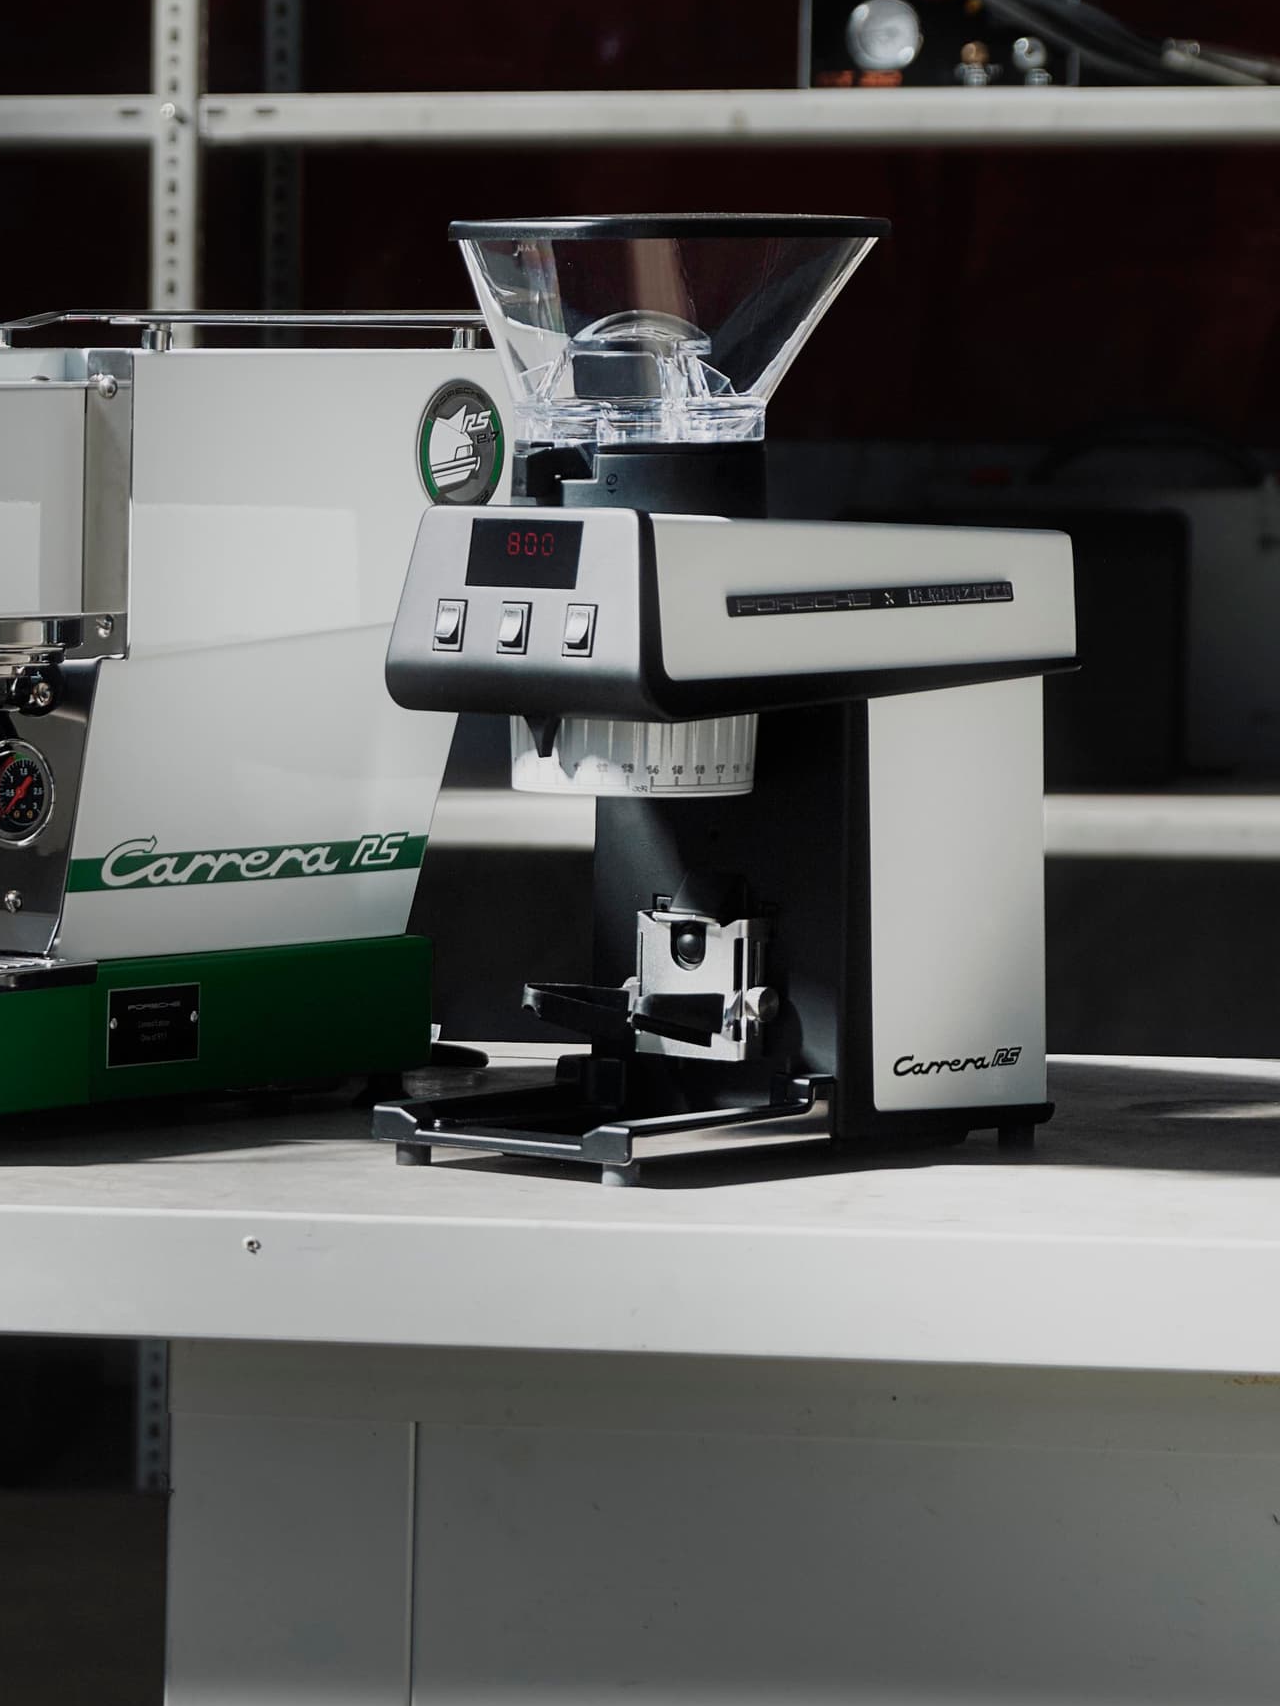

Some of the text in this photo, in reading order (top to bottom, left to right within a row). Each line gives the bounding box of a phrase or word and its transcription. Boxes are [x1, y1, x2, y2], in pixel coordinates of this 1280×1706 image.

[461, 410, 492, 433] RS
[508, 532, 555, 557] 800
[736, 593, 871, 613] PORSCHE
[100, 831, 410, 888] Carrera RS
[893, 1046, 1022, 1077] Carrera RS
